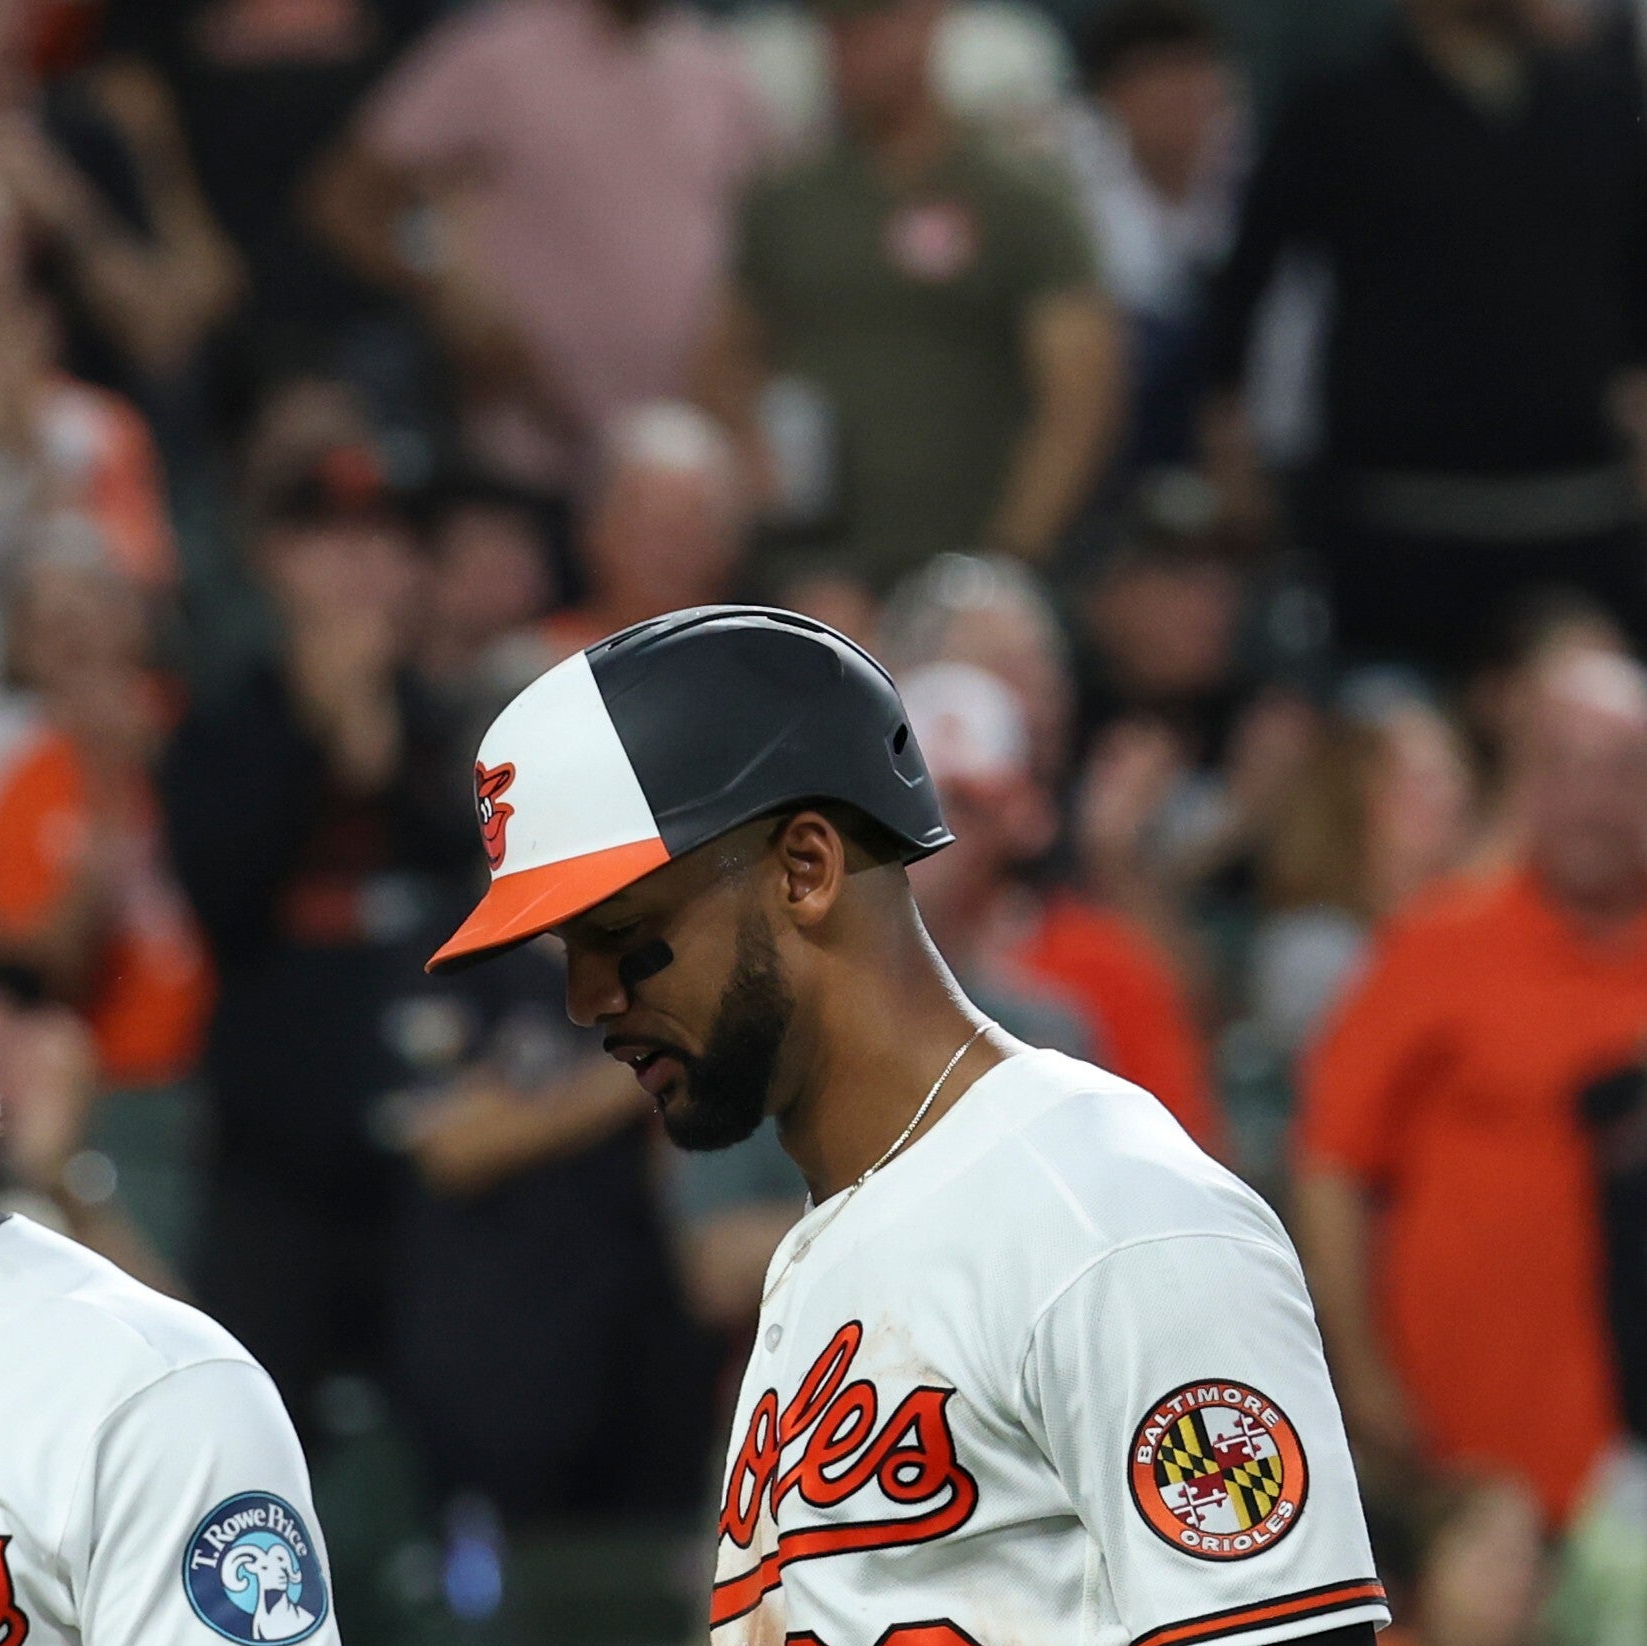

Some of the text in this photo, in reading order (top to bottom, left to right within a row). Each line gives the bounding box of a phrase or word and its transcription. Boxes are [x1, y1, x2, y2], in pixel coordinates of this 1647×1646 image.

[717, 1319, 979, 1550] oles
[1137, 1386, 1280, 1465] BALTIMORE
[191, 1502, 308, 1571] T. Rowe Price
[1180, 1500, 1295, 1552] ORIOLES
